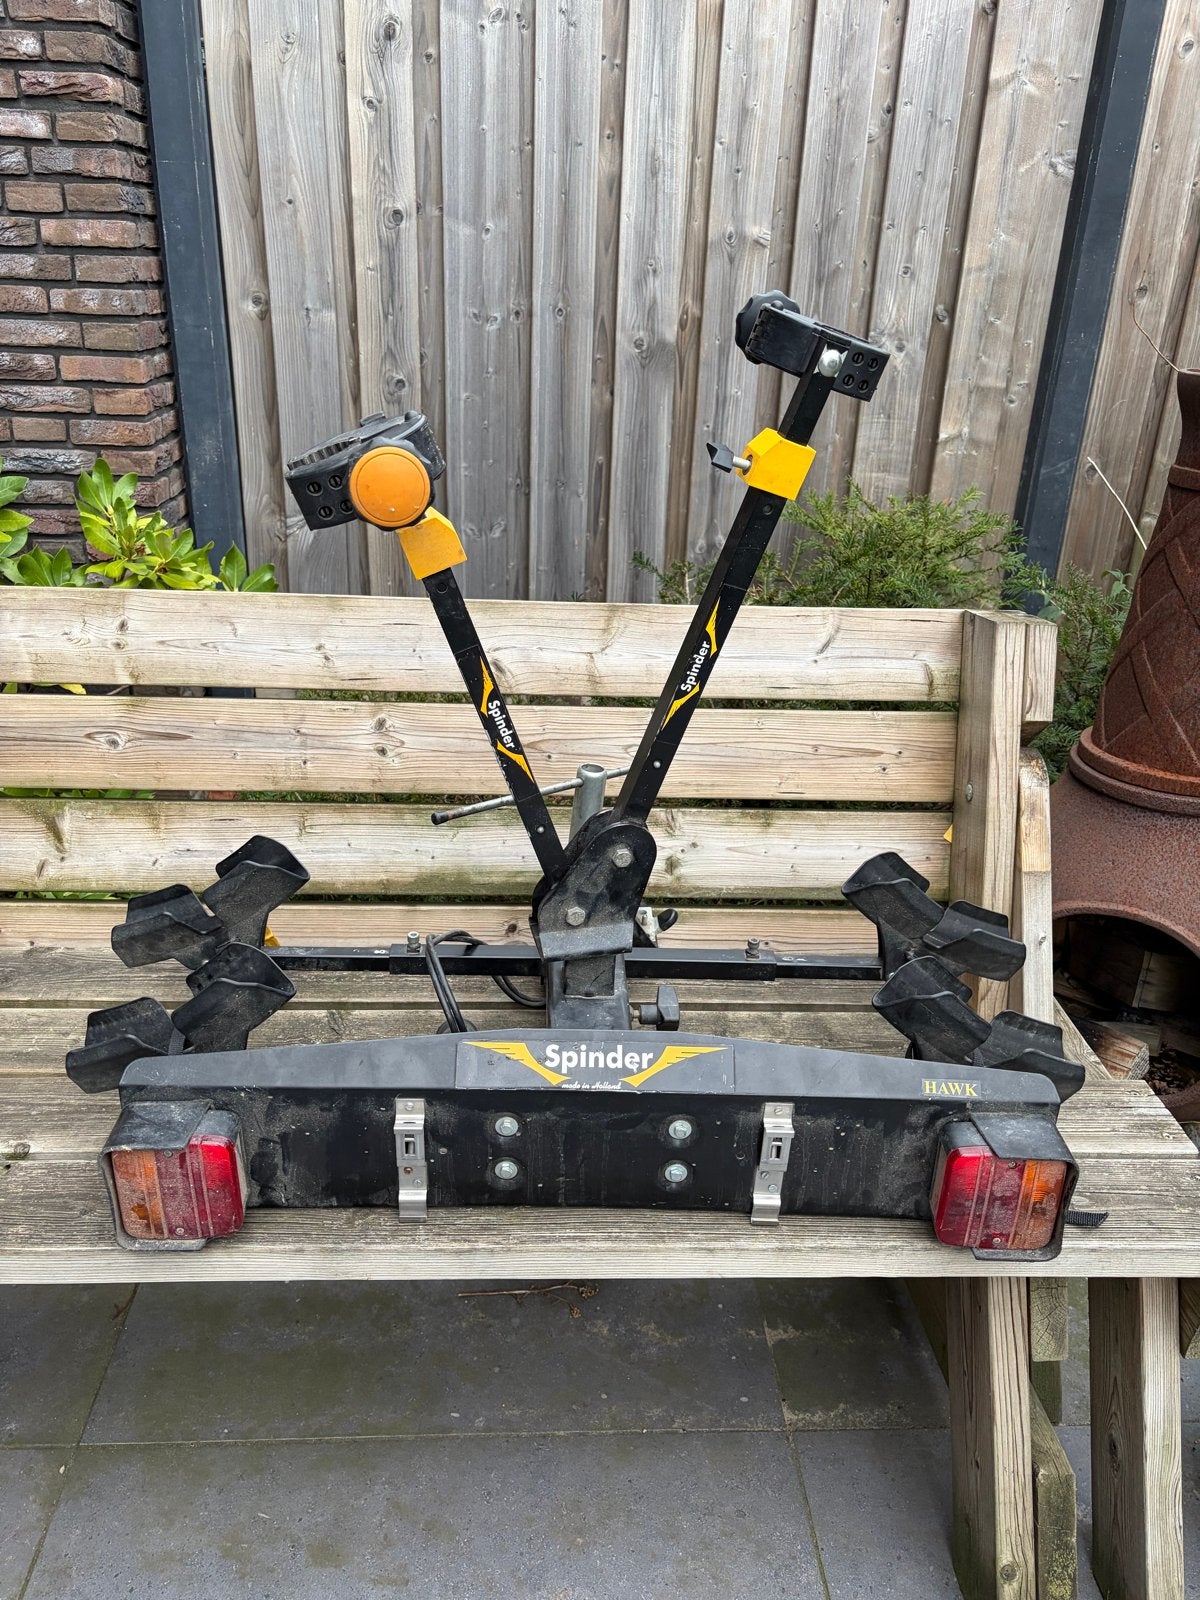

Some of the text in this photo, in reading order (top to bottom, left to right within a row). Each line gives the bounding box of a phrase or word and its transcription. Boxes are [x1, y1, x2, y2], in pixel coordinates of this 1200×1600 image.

[680, 640, 711, 692] Spinder
[488, 699, 515, 750] Spinder
[544, 1044, 654, 1074] Spinder
[561, 1080, 581, 1089] made
[591, 1081, 622, 1090] Holland
[924, 1080, 978, 1097] HAWK
